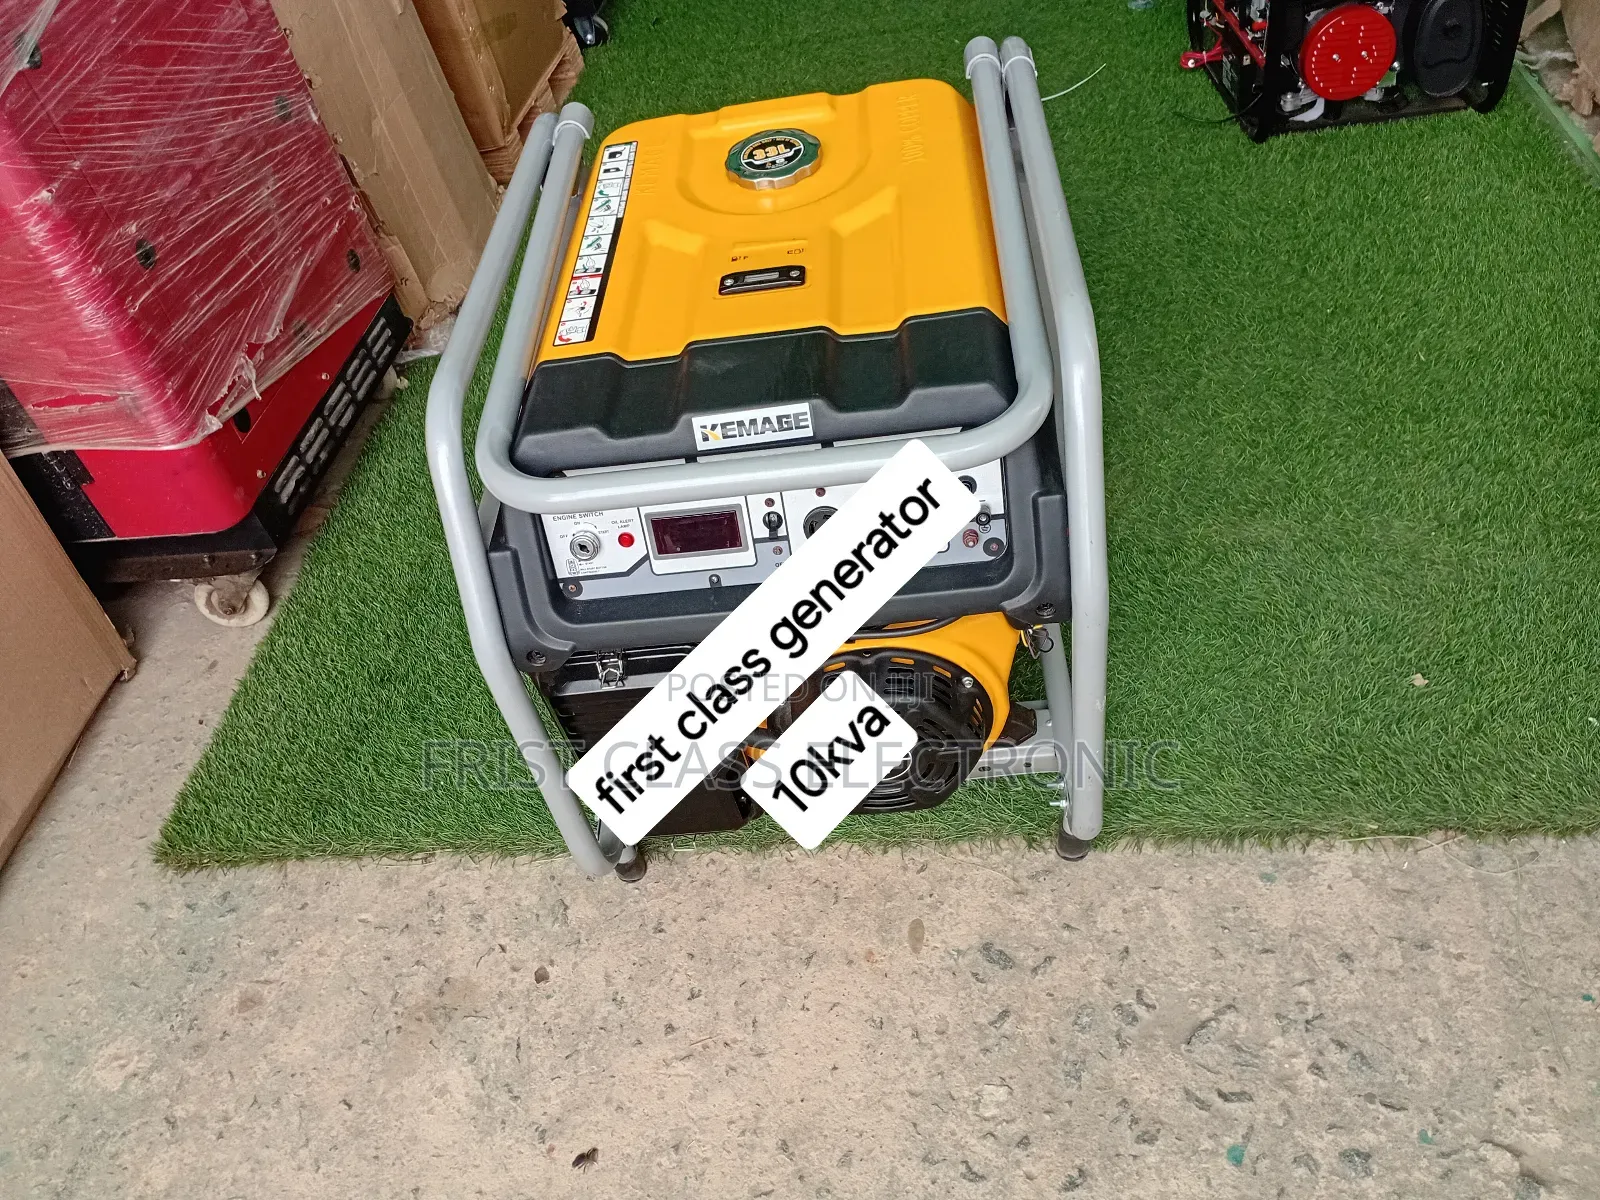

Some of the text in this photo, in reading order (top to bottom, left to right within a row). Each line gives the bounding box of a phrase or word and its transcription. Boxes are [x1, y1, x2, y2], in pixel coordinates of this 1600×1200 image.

[752, 143, 791, 161] 33L
[700, 411, 810, 443] KEMAGE
[552, 511, 604, 522] ENGINE SWITCH
